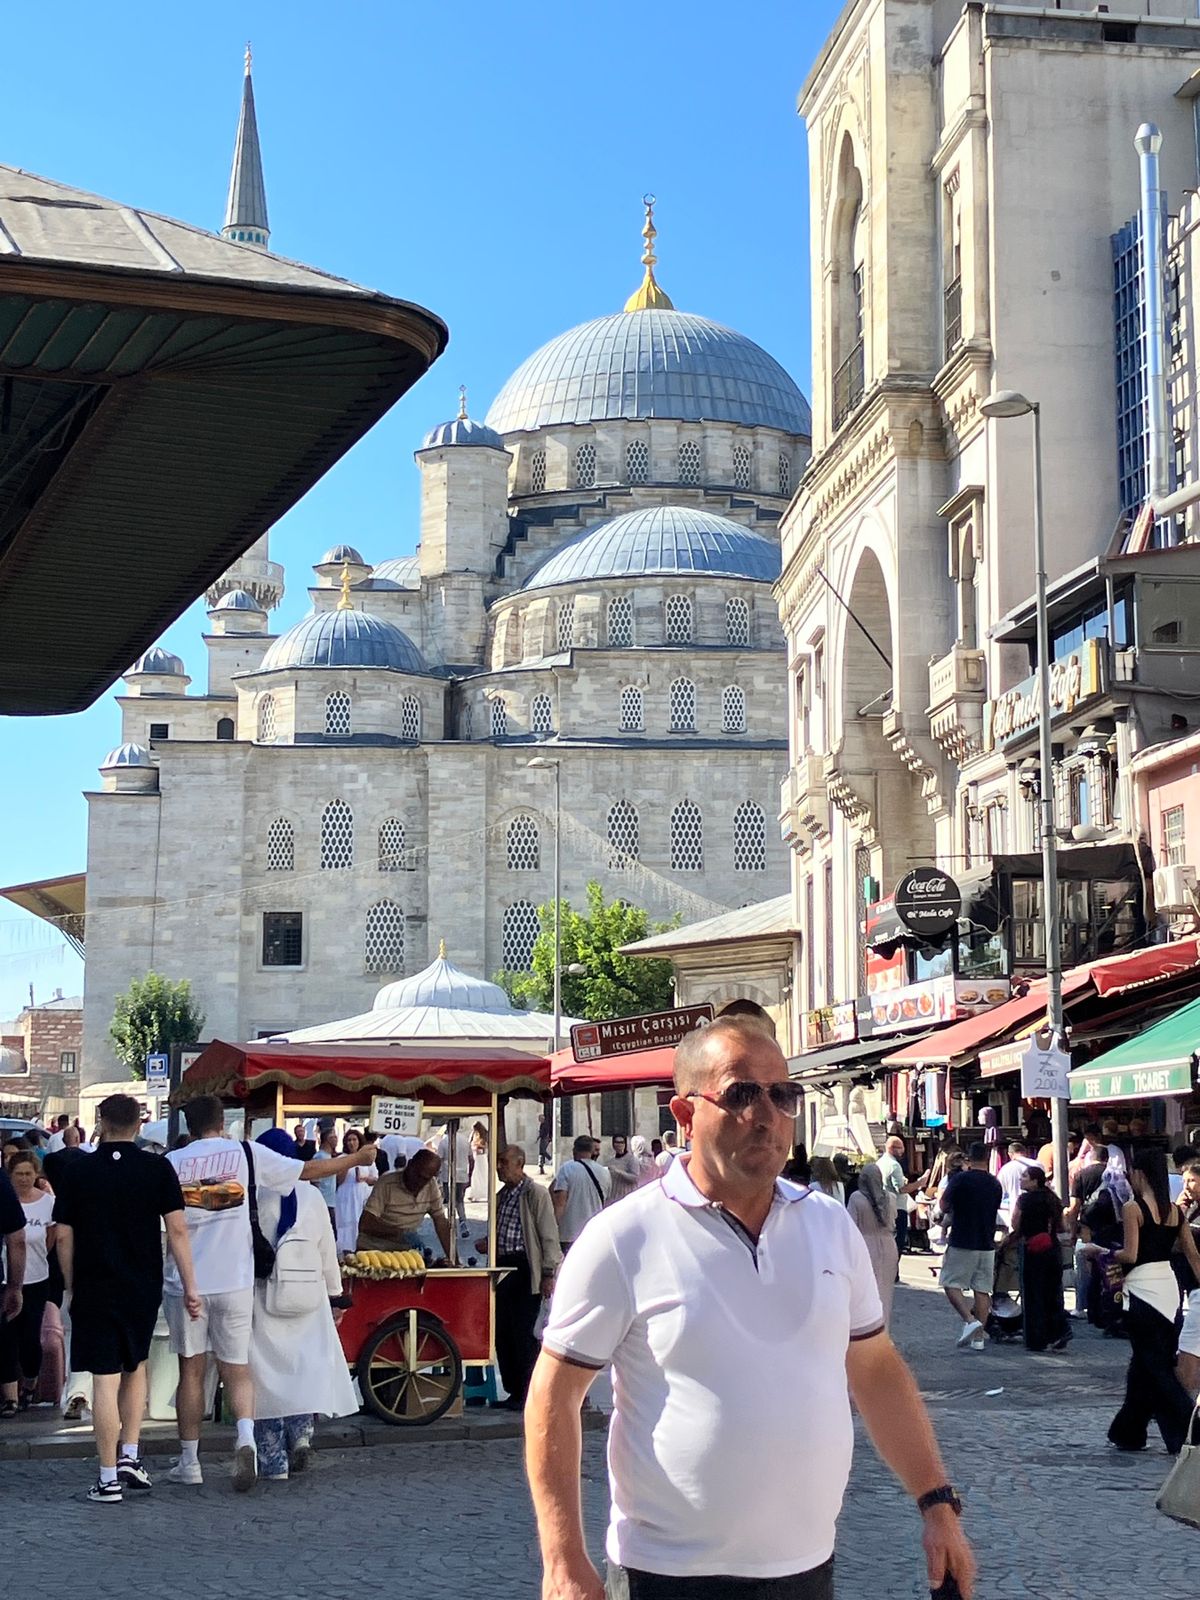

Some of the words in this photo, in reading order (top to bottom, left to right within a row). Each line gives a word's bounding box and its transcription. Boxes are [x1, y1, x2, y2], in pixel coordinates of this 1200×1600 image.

[602, 1023, 637, 1038] Mısır
[641, 1014, 690, 1034] Çarşısı
[1034, 1078, 1058, 1091] 200
[1085, 1079, 1101, 1098] EFE
[1110, 1075, 1122, 1095] AV
[1132, 1069, 1170, 1093] TİCARET
